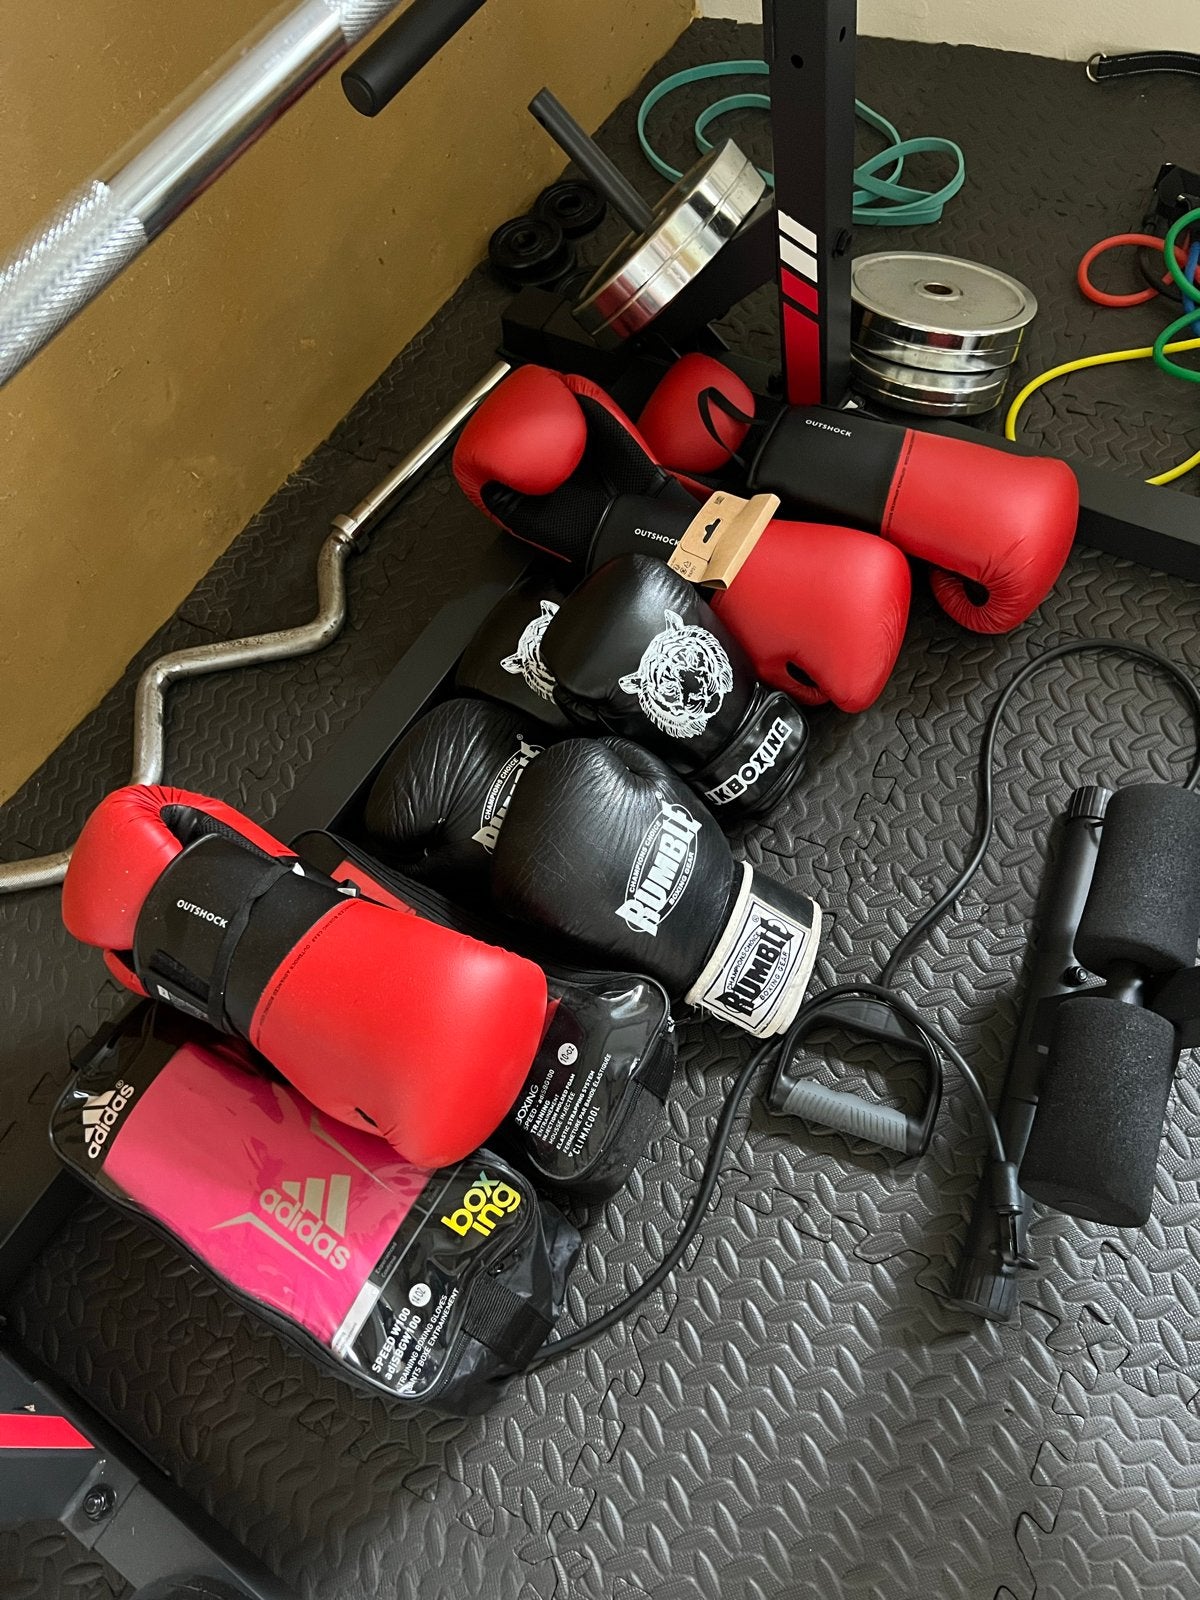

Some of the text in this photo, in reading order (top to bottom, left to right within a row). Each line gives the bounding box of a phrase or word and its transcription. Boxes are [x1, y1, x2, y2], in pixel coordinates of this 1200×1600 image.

[805, 420, 853, 438] OUTSHOCK
[485, 757, 519, 820] CHAMPIONS CHOICE
[614, 800, 703, 937] RUMBLE
[628, 820, 662, 893] CHAMPIONS CHOICE
[668, 851, 695, 905] BOXING GEAR
[176, 899, 228, 928] OUTSHOCK
[714, 916, 794, 1016] RUMBLE
[726, 931, 761, 990] CHAMPIONS CHOICE
[760, 951, 789, 1001] BOXING GEAR
[87, 1084, 135, 1159] adidas
[530, 1099, 551, 1135] TRAINING
[541, 1073, 575, 1141] INJECTION MOLDED FOAM
[548, 1119, 563, 1145] MOUSSE
[555, 1070, 595, 1150] ELASTIC STRAPPING SYSTEM
[562, 1119, 583, 1153] FERMETURE
[579, 1107, 588, 1120] PAR
[584, 1087, 596, 1107] BANDE
[572, 1104, 600, 1155] CLIMACOOL
[260, 1188, 350, 1270] adidas
[441, 1171, 501, 1237] box
[473, 1180, 523, 1238] ing
[371, 1306, 412, 1374] SPEED W100
[382, 1314, 422, 1381] adiSBGW100
[396, 1294, 449, 1387] TRAINING BOXING GLOVES
[417, 1346, 432, 1367] BOXE
[428, 1288, 460, 1346] ENTRAINEMENT
